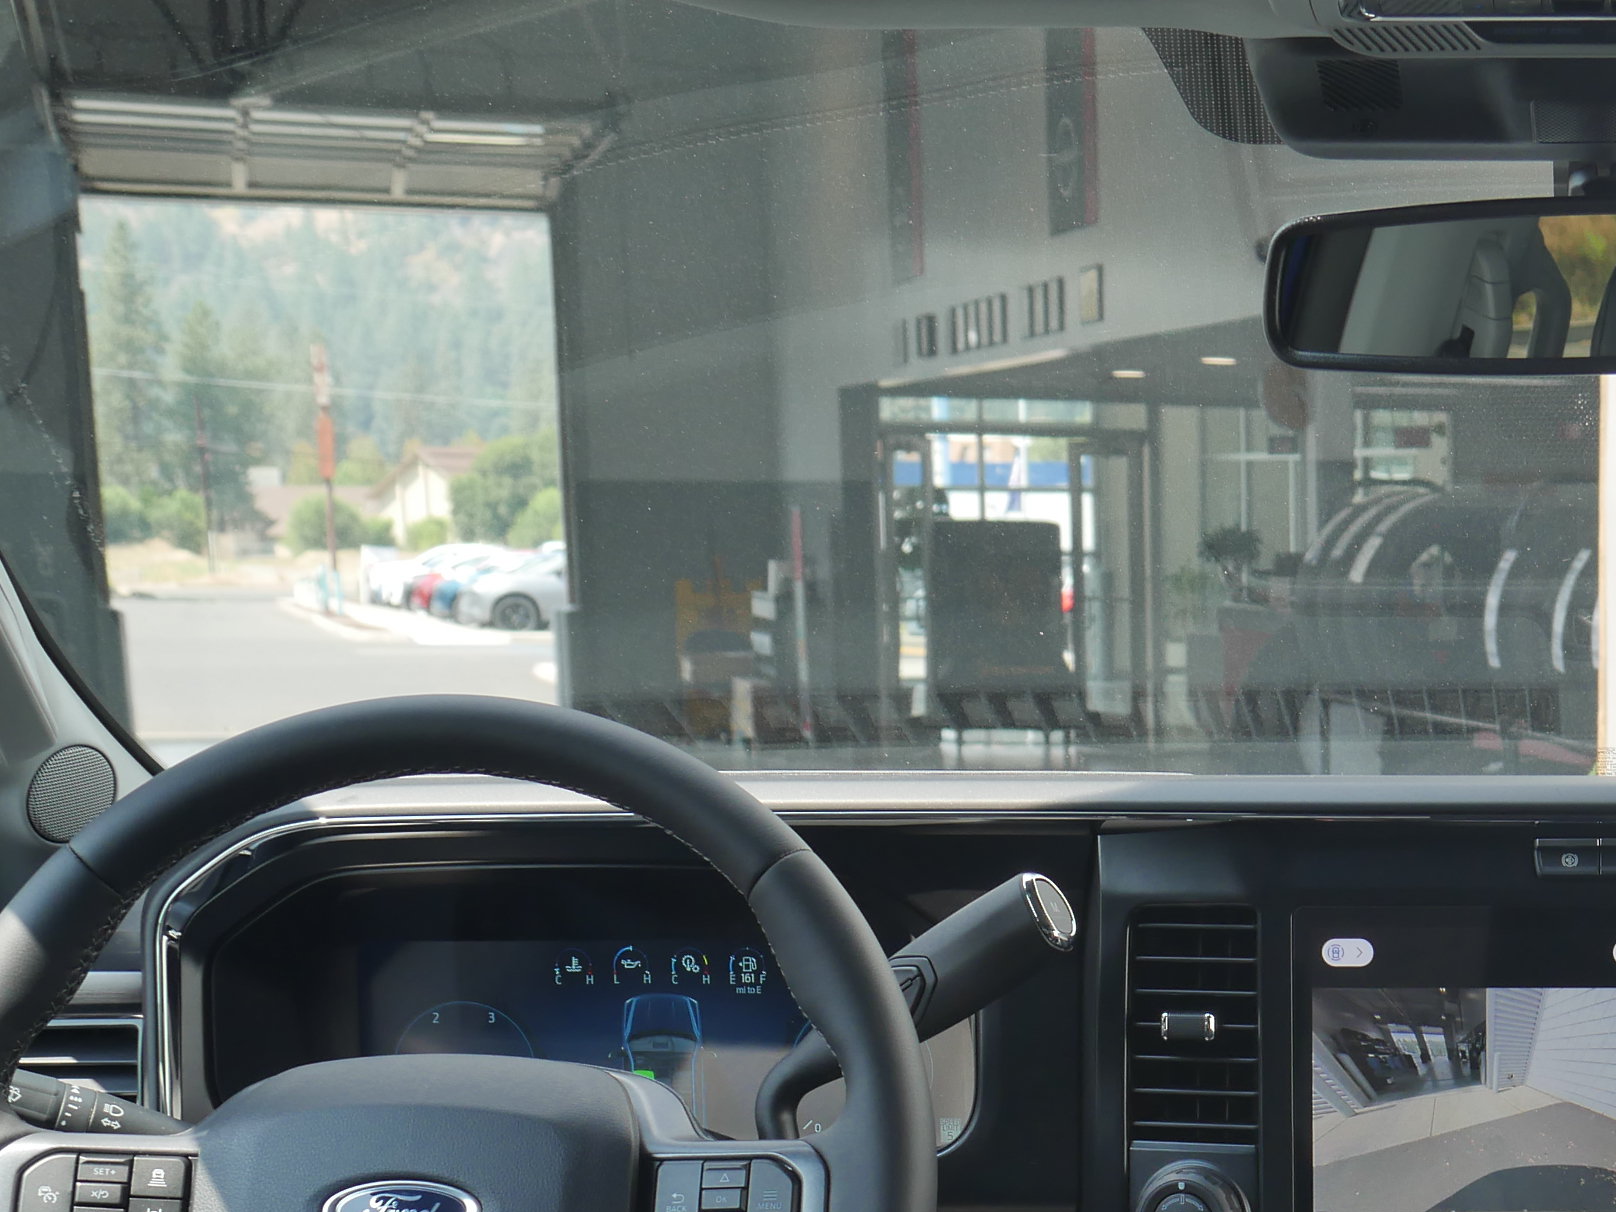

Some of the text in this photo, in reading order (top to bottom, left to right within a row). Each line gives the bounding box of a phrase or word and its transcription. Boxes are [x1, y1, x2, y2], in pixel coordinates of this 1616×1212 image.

[555, 975, 562, 985] C
[586, 975, 594, 985] H
[613, 975, 620, 984] L
[643, 975, 652, 984] H
[671, 975, 678, 984] C
[702, 975, 710, 984] H
[729, 973, 766, 984] E 161 F
[756, 986, 762, 994] E
[432, 1012, 440, 1024] 2
[488, 1012, 495, 1023] 3
[757, 1202, 782, 1210] MENU
